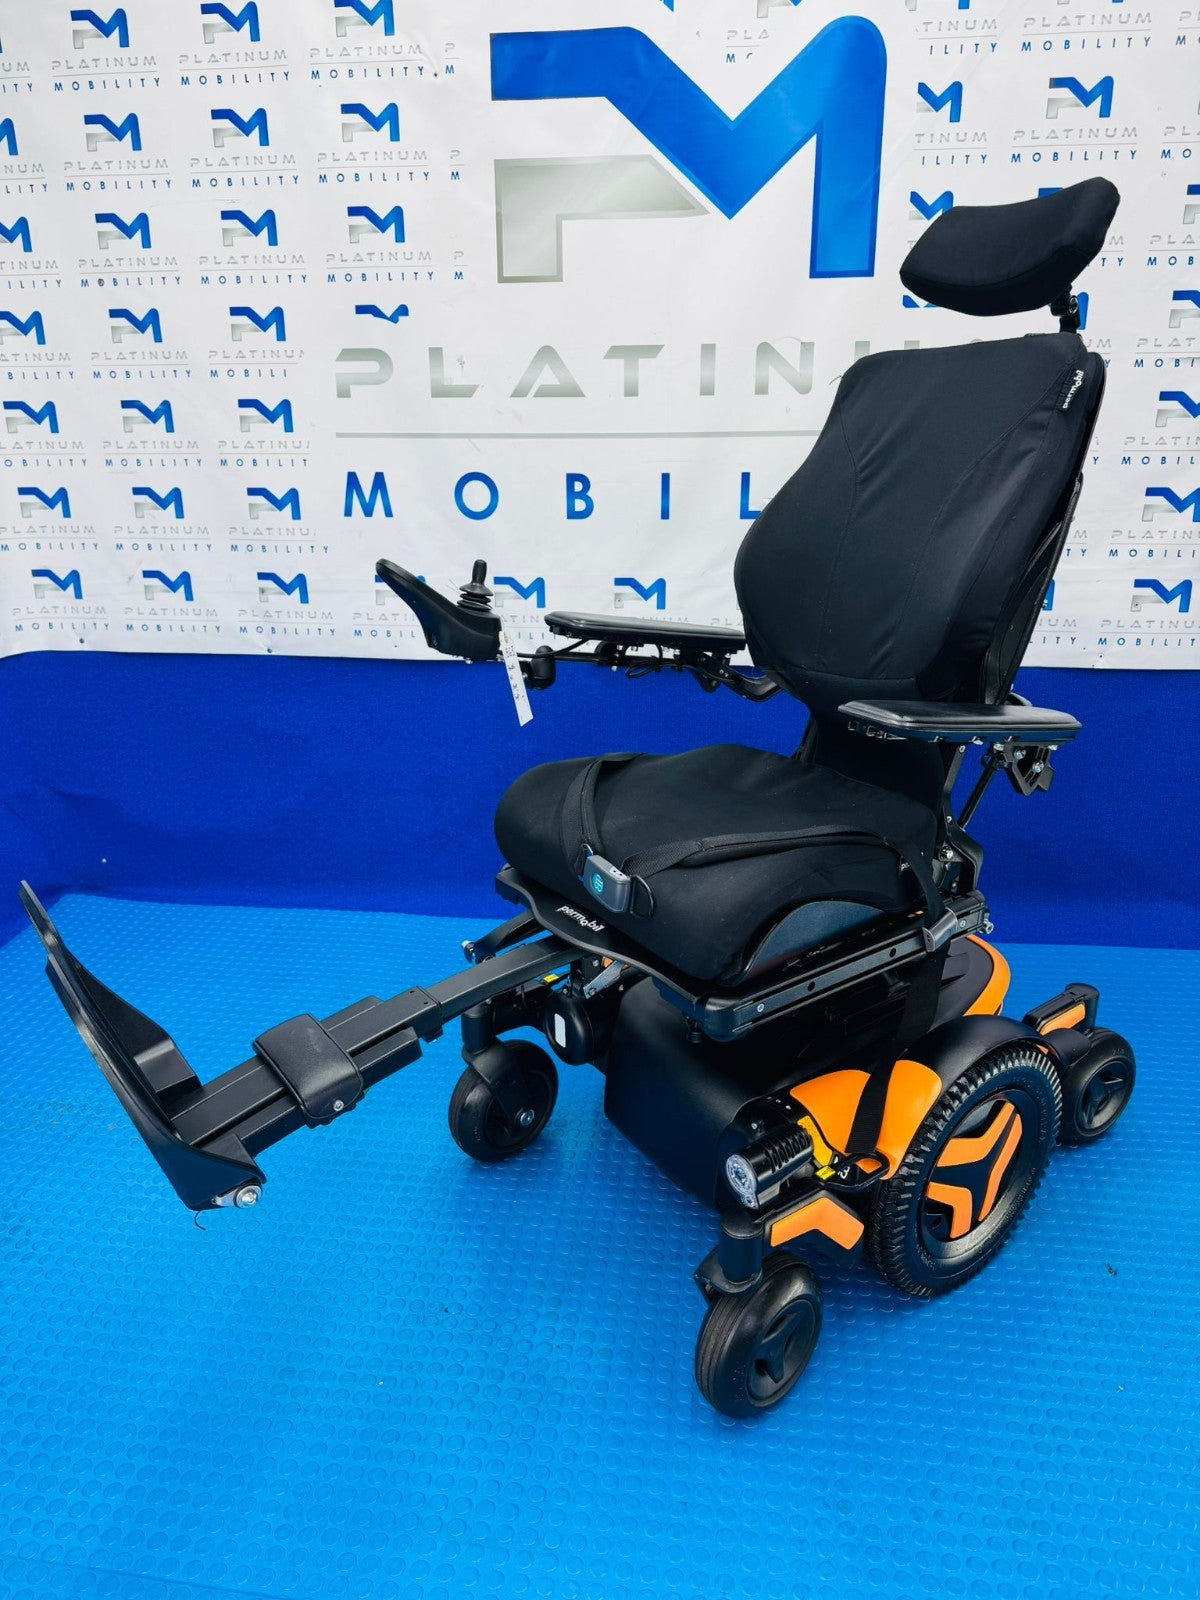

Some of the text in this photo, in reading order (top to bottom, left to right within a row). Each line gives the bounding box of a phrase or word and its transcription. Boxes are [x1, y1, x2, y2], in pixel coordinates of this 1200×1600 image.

[916, 19, 997, 32] TINUM
[1024, 13, 1152, 28] PLATINUM
[1021, 36, 1150, 52] MOBILITY
[179, 49, 287, 64] PLATINUM
[310, 44, 422, 58] PLATINUM
[52, 55, 157, 70] PLATINUM
[181, 71, 289, 85] MOBILITY
[311, 66, 424, 79] MOBILITY
[55, 77, 160, 91] MOBILITY
[1014, 127, 1137, 141] PLATINUM
[190, 154, 296, 167] PLATINUM
[318, 151, 427, 162] PLATINUM
[1011, 150, 1136, 163] MOBILITY
[64, 160, 168, 171] PLATINUM
[192, 175, 299, 187] MOBILITY
[319, 172, 429, 183] MOBILITY
[66, 180, 171, 190] MOBILITY
[79, 256, 177, 267] PLATINUM
[200, 254, 305, 265] PLATINUM
[327, 251, 432, 262] PLATINUM
[81, 276, 181, 287] MOBILITY
[201, 274, 307, 285] MOBILITY
[328, 272, 433, 283] MOBILITY
[91, 351, 187, 360] PLATINUM
[93, 369, 191, 379] MOBILITY
[335, 340, 989, 398] PLATIN
[1062, 370, 1084, 408] permobil
[103, 440, 199, 449] PLATINUM
[105, 458, 202, 467] MOBILITY
[0, 526, 94, 535] PLATINUM
[114, 525, 208, 535] PLATINUM
[229, 526, 316, 536] PLATINU
[1112, 530, 1200, 539] PLATIN
[0, 542, 99, 551] MOBILITY
[116, 542, 212, 552] MOBILITY
[231, 544, 328, 554] MOBILITY
[12, 606, 106, 615] PLATINUM
[124, 607, 217, 617] PLATINUM
[238, 609, 333, 619] PLATINUM
[15, 622, 109, 632] MOBILITY
[126, 623, 220, 633] MOBILITY
[1101, 619, 1200, 629] PLATINU
[240, 625, 335, 635] MOBILITY
[557, 905, 606, 932] permobil
